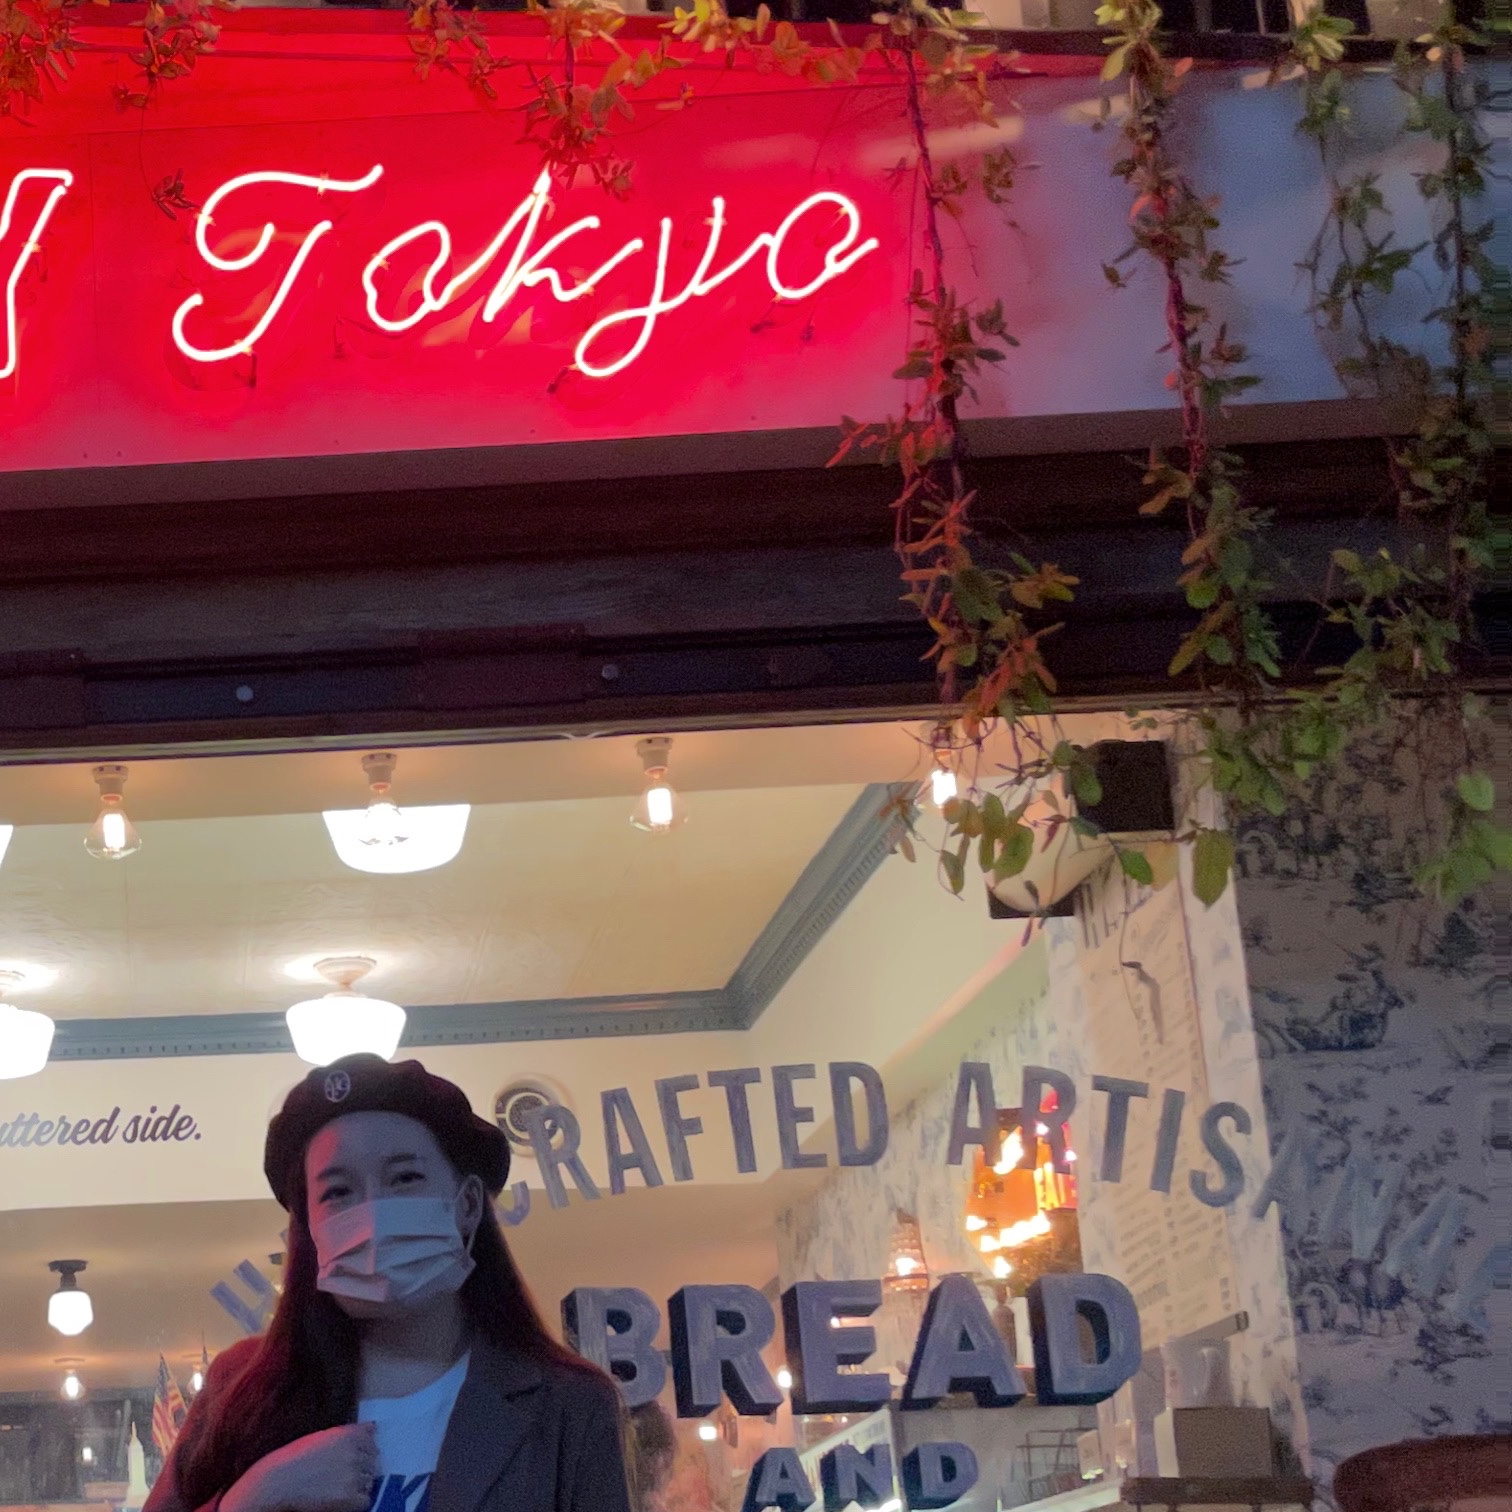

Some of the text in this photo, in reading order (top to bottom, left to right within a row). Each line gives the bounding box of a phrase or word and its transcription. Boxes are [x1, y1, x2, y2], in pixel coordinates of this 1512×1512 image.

[171, 164, 878, 378] Tokyo
[121, 1103, 202, 1144] side.
[561, 1273, 1141, 1418] BREAD
